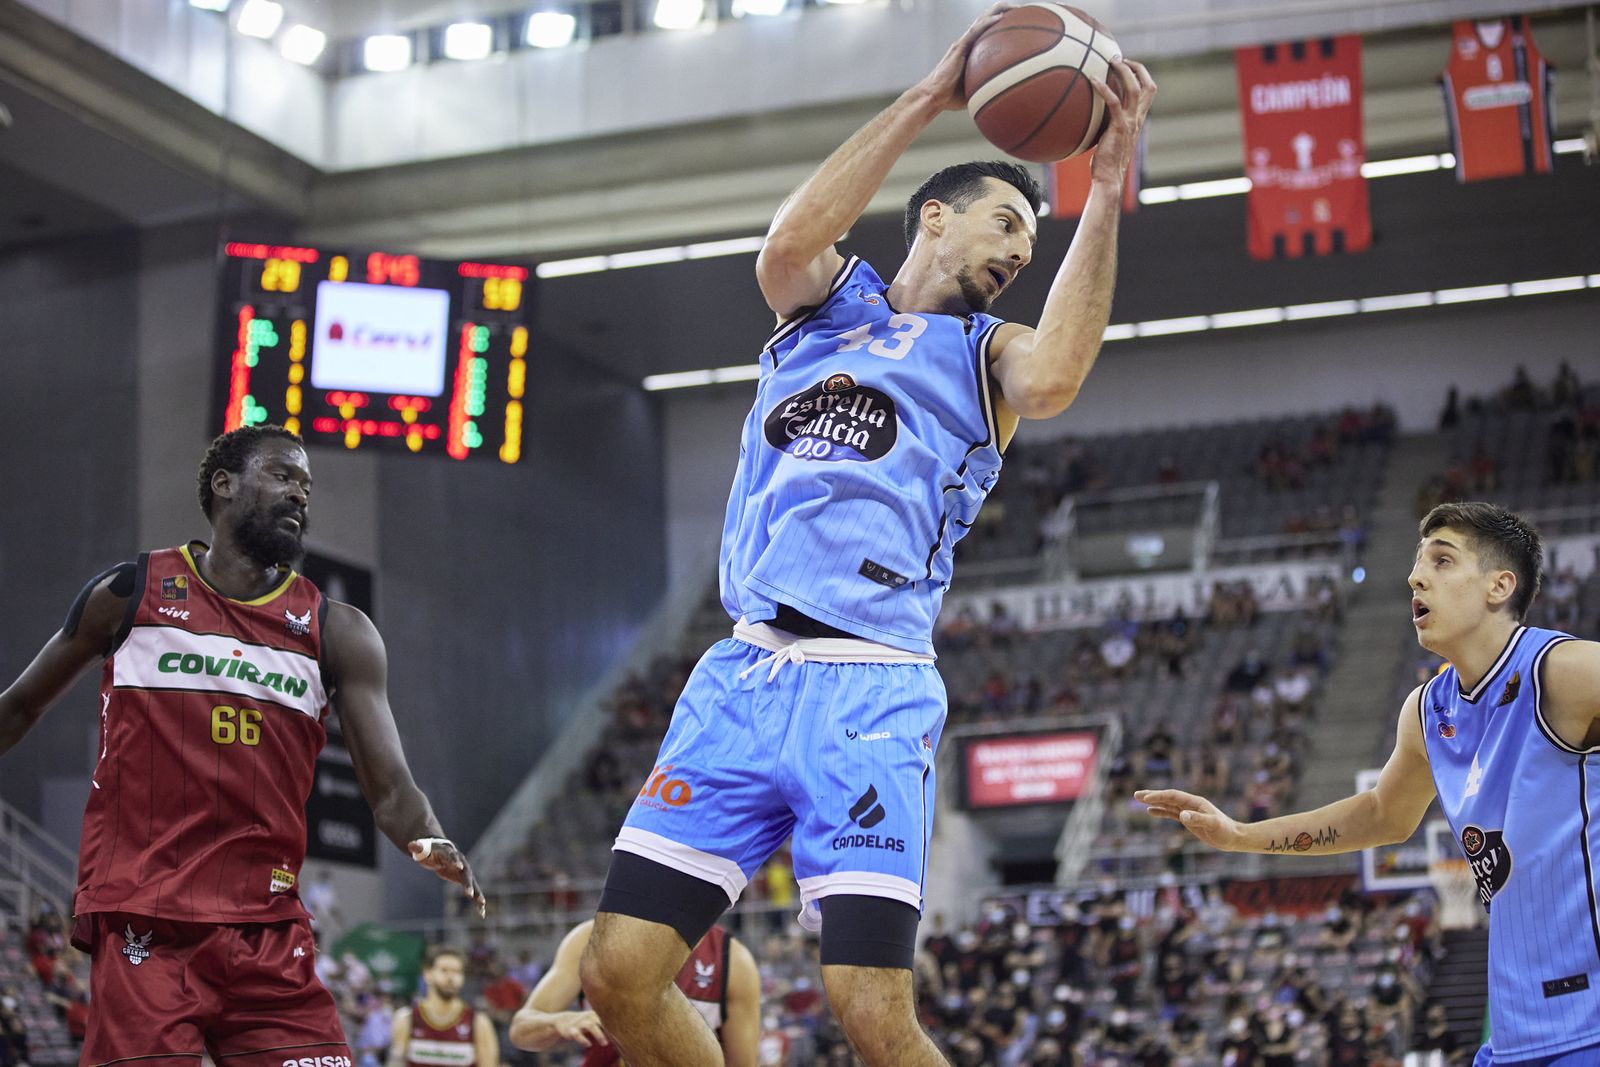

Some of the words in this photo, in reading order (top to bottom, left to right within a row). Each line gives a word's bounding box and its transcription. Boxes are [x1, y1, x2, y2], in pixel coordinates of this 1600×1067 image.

[1251, 73, 1350, 115] CAMPEÓN
[780, 393, 887, 428] Estrella
[785, 413, 870, 450] Galicia
[158, 606, 190, 620] vive
[210, 705, 263, 746] 66
[640, 765, 692, 807] ío
[832, 834, 905, 853] CANDELAS
